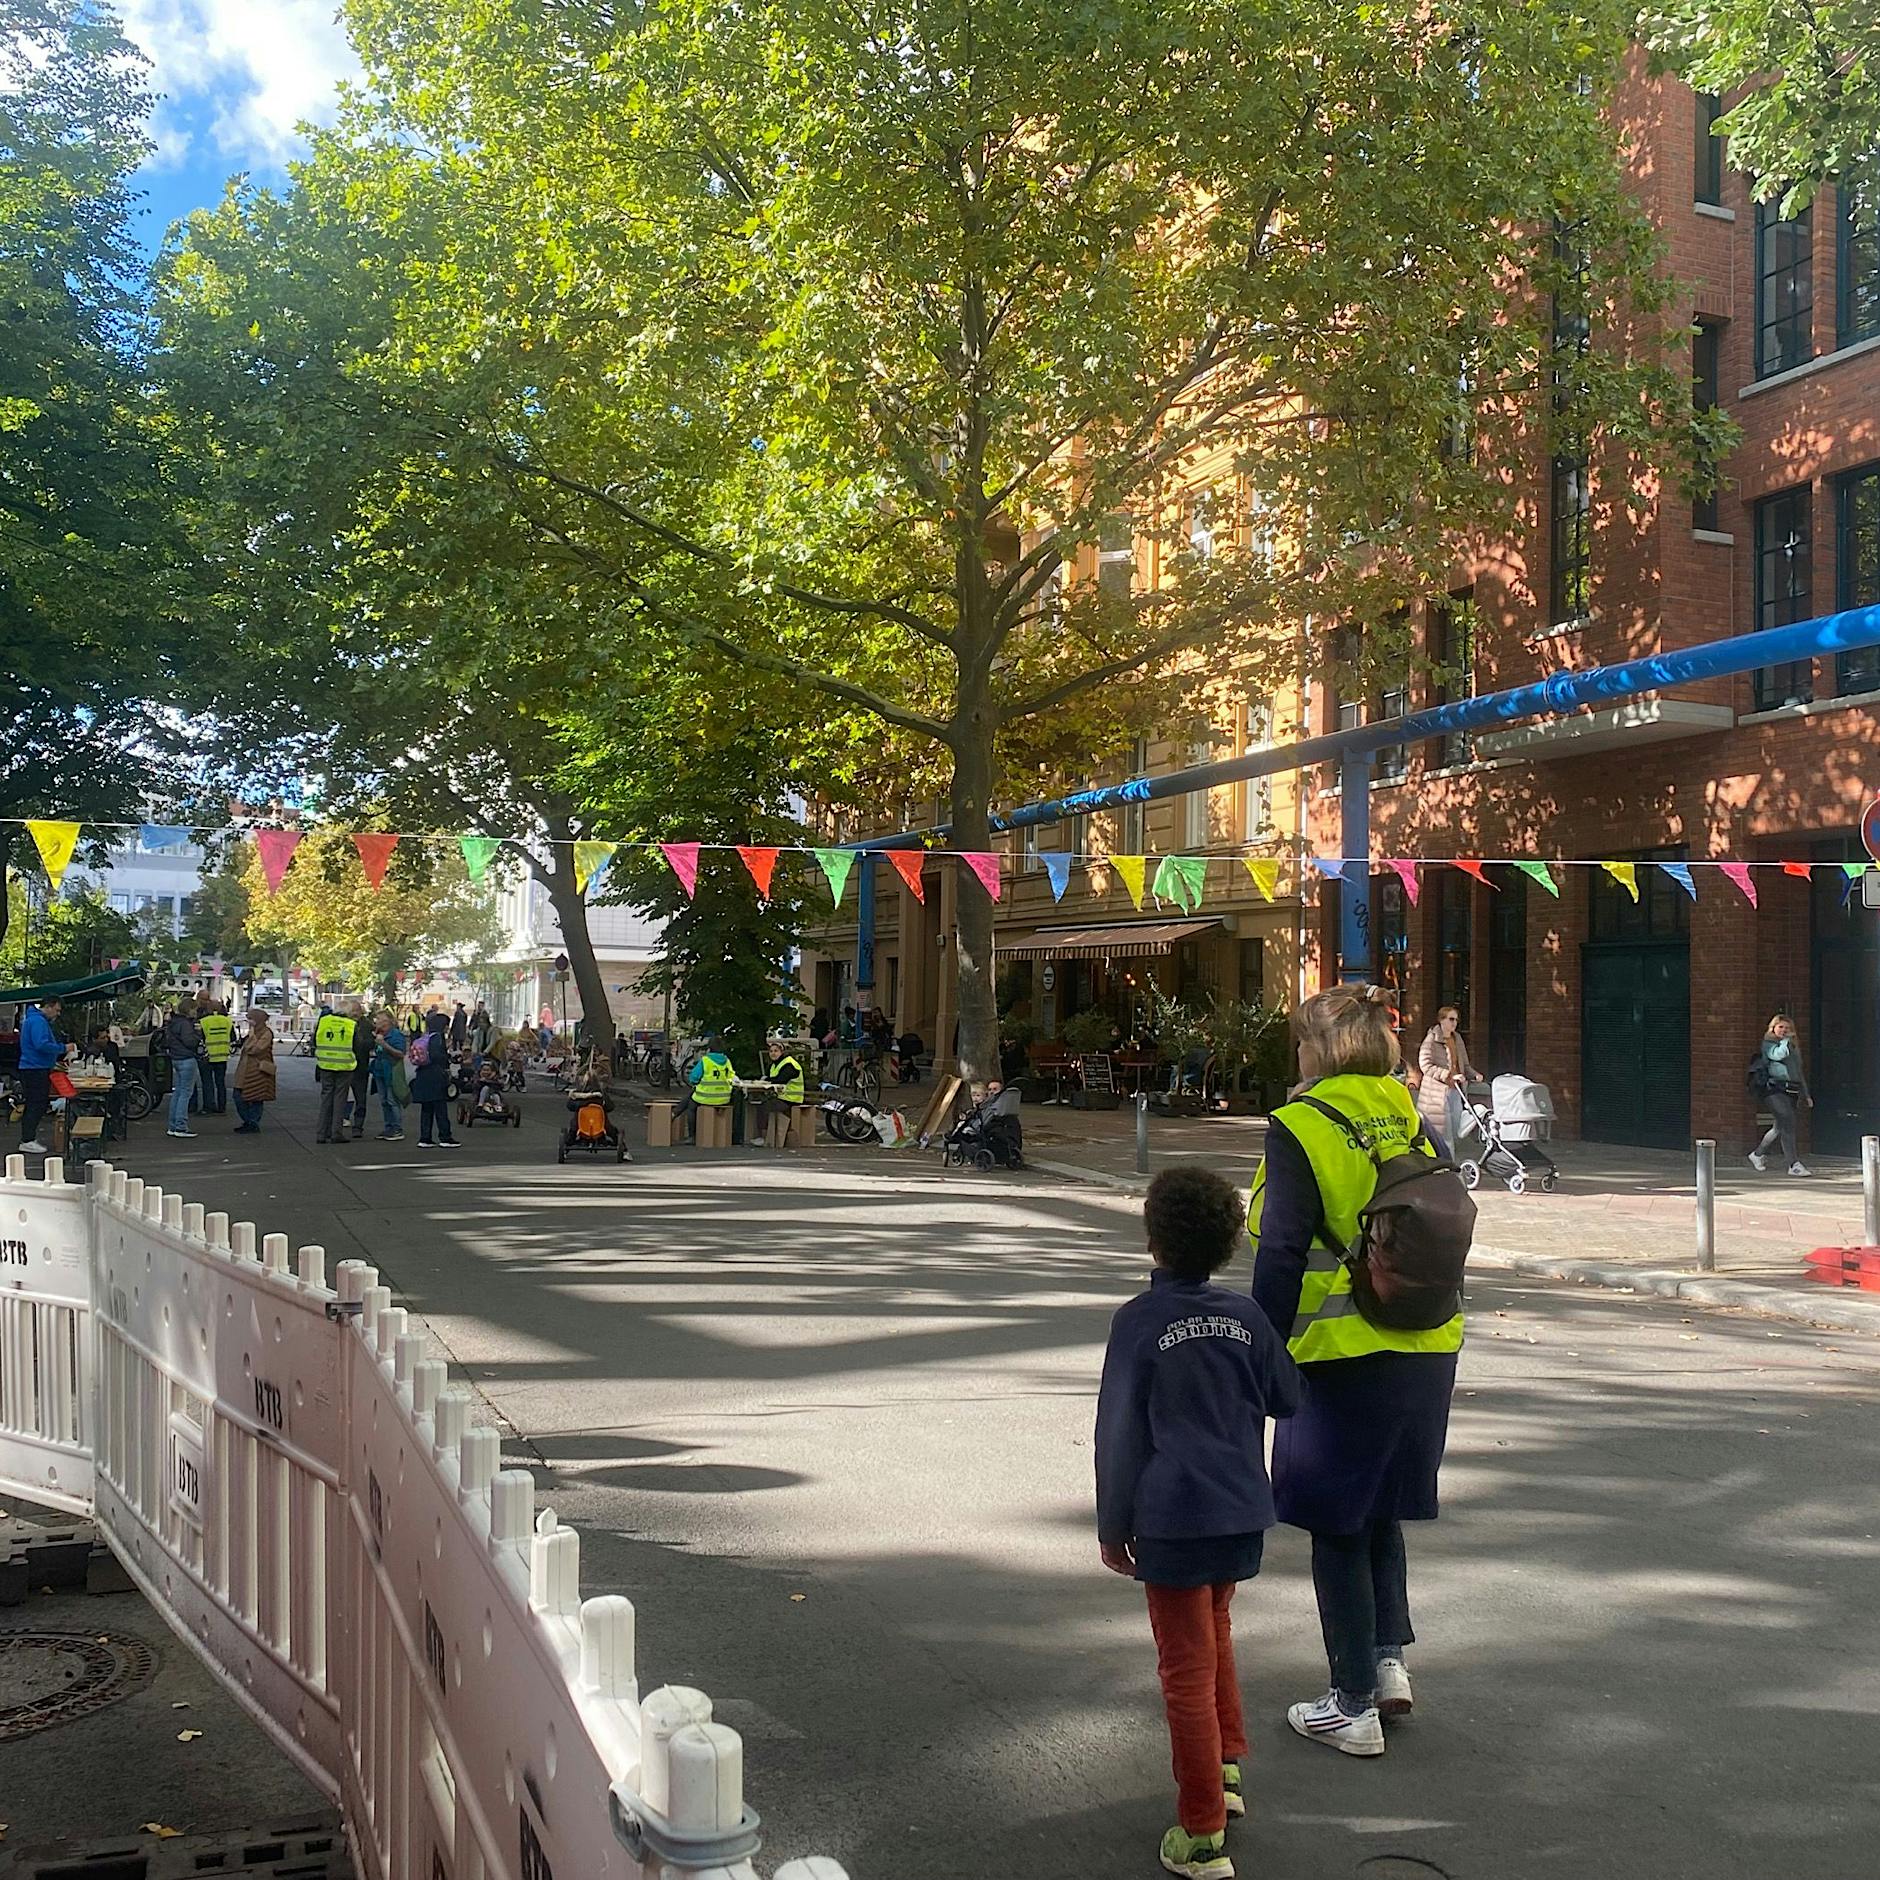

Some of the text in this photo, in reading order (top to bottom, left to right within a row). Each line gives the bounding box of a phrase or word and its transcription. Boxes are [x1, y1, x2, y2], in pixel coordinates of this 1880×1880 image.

[1347, 1134, 1377, 1150] Oe
[254, 1376, 283, 1430] BTB
[179, 1453, 199, 1504] BTB
